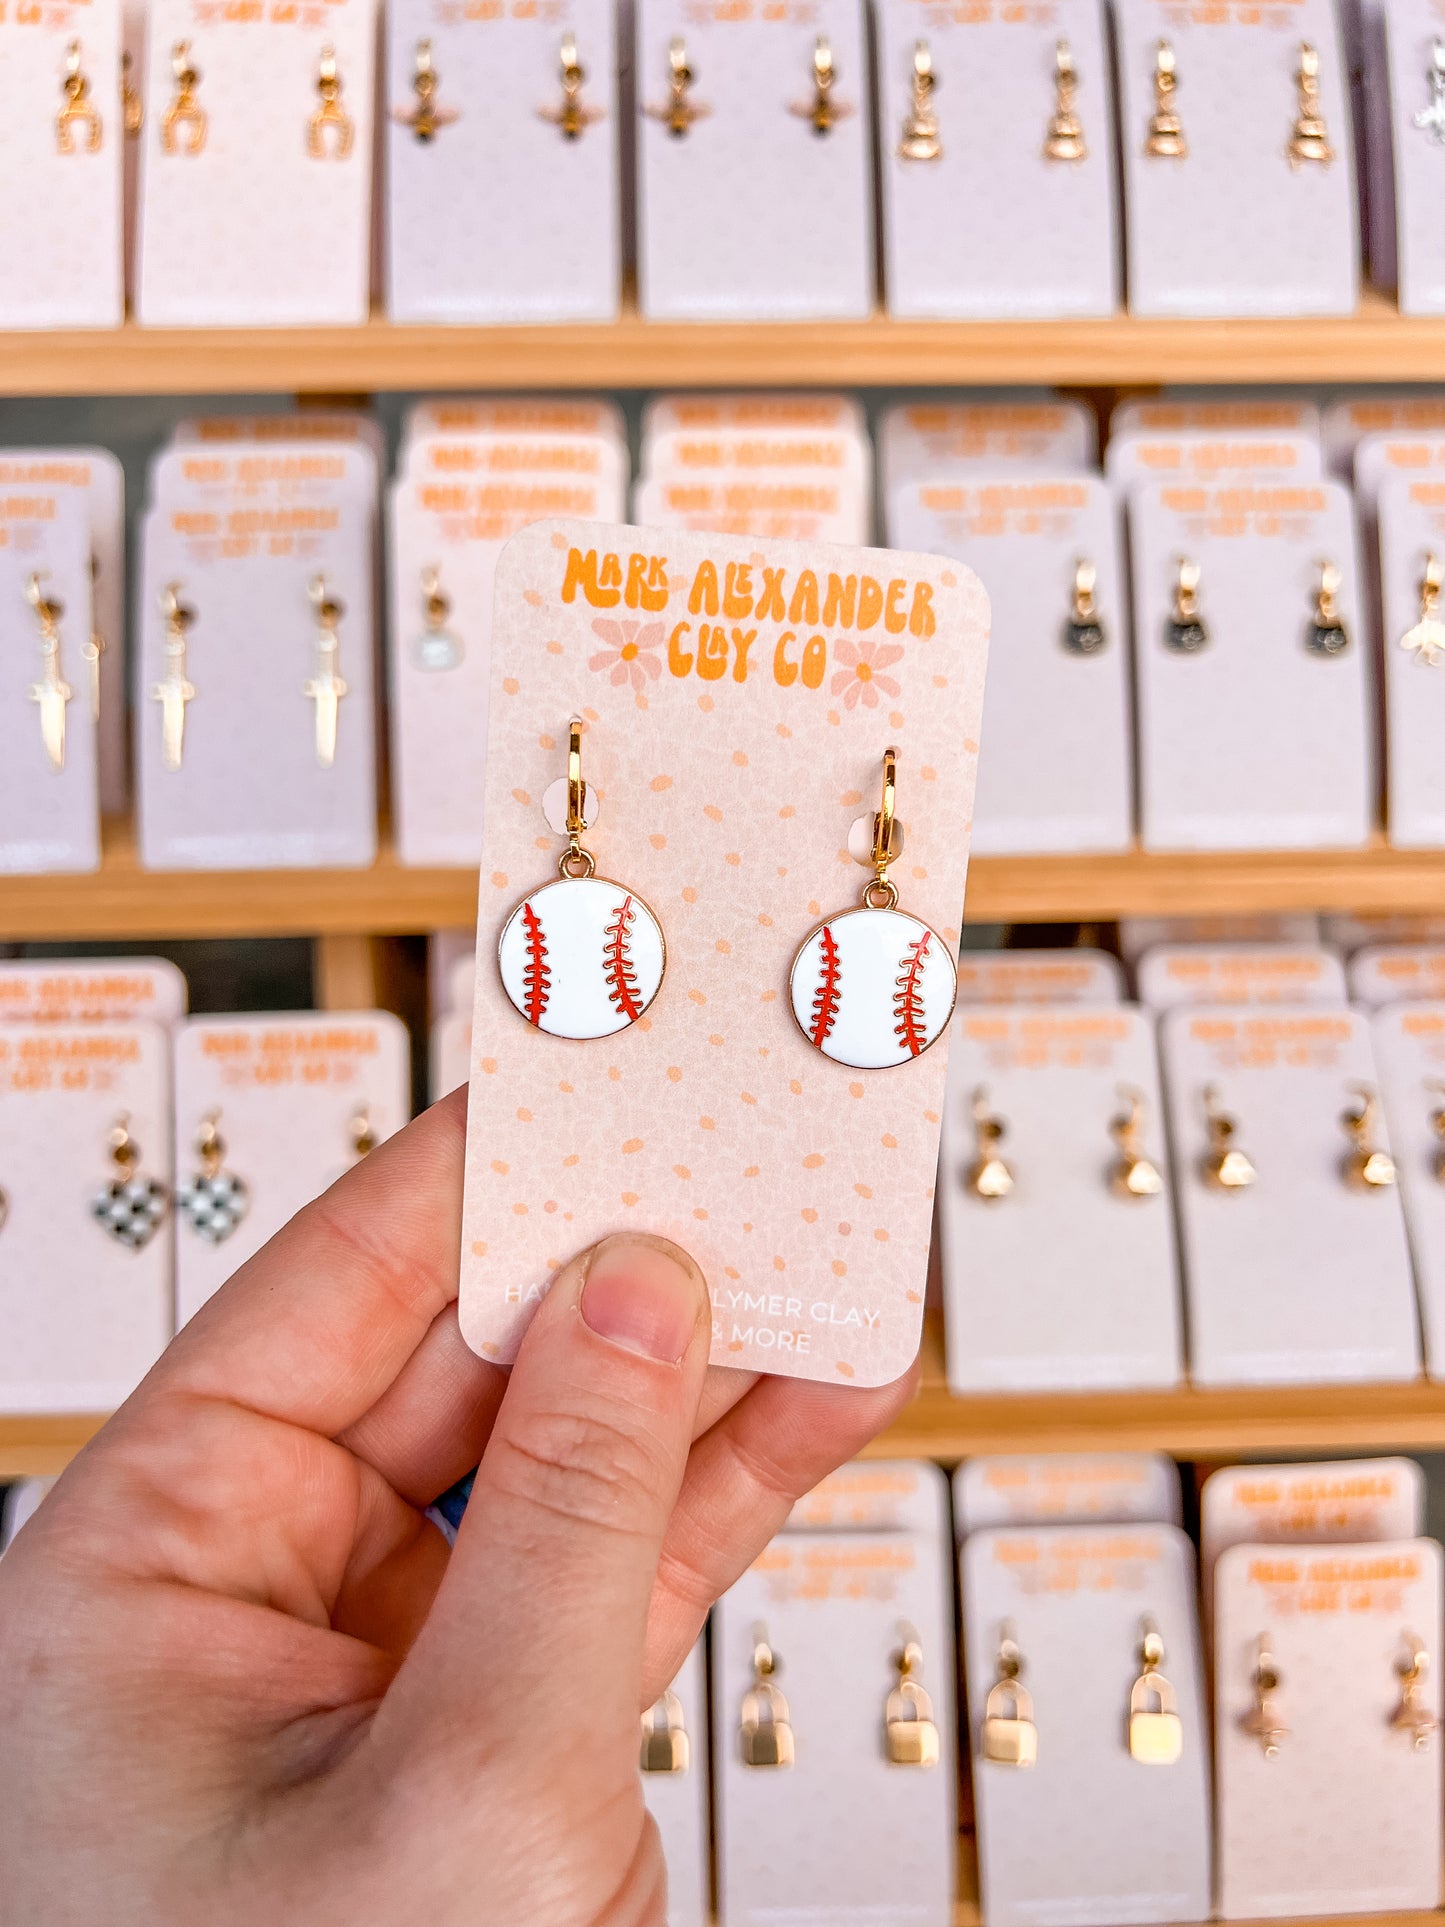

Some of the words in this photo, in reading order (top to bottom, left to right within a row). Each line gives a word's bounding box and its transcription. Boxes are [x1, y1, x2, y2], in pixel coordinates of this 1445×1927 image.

[561, 547, 669, 612] MARK
[687, 560, 936, 637] ALEXANDER
[667, 621, 758, 684] CLAY
[773, 631, 827, 689] CO
[711, 1287, 802, 1319] LYMER
[809, 1302, 881, 1330] CLAY
[731, 1323, 812, 1354] MORE
